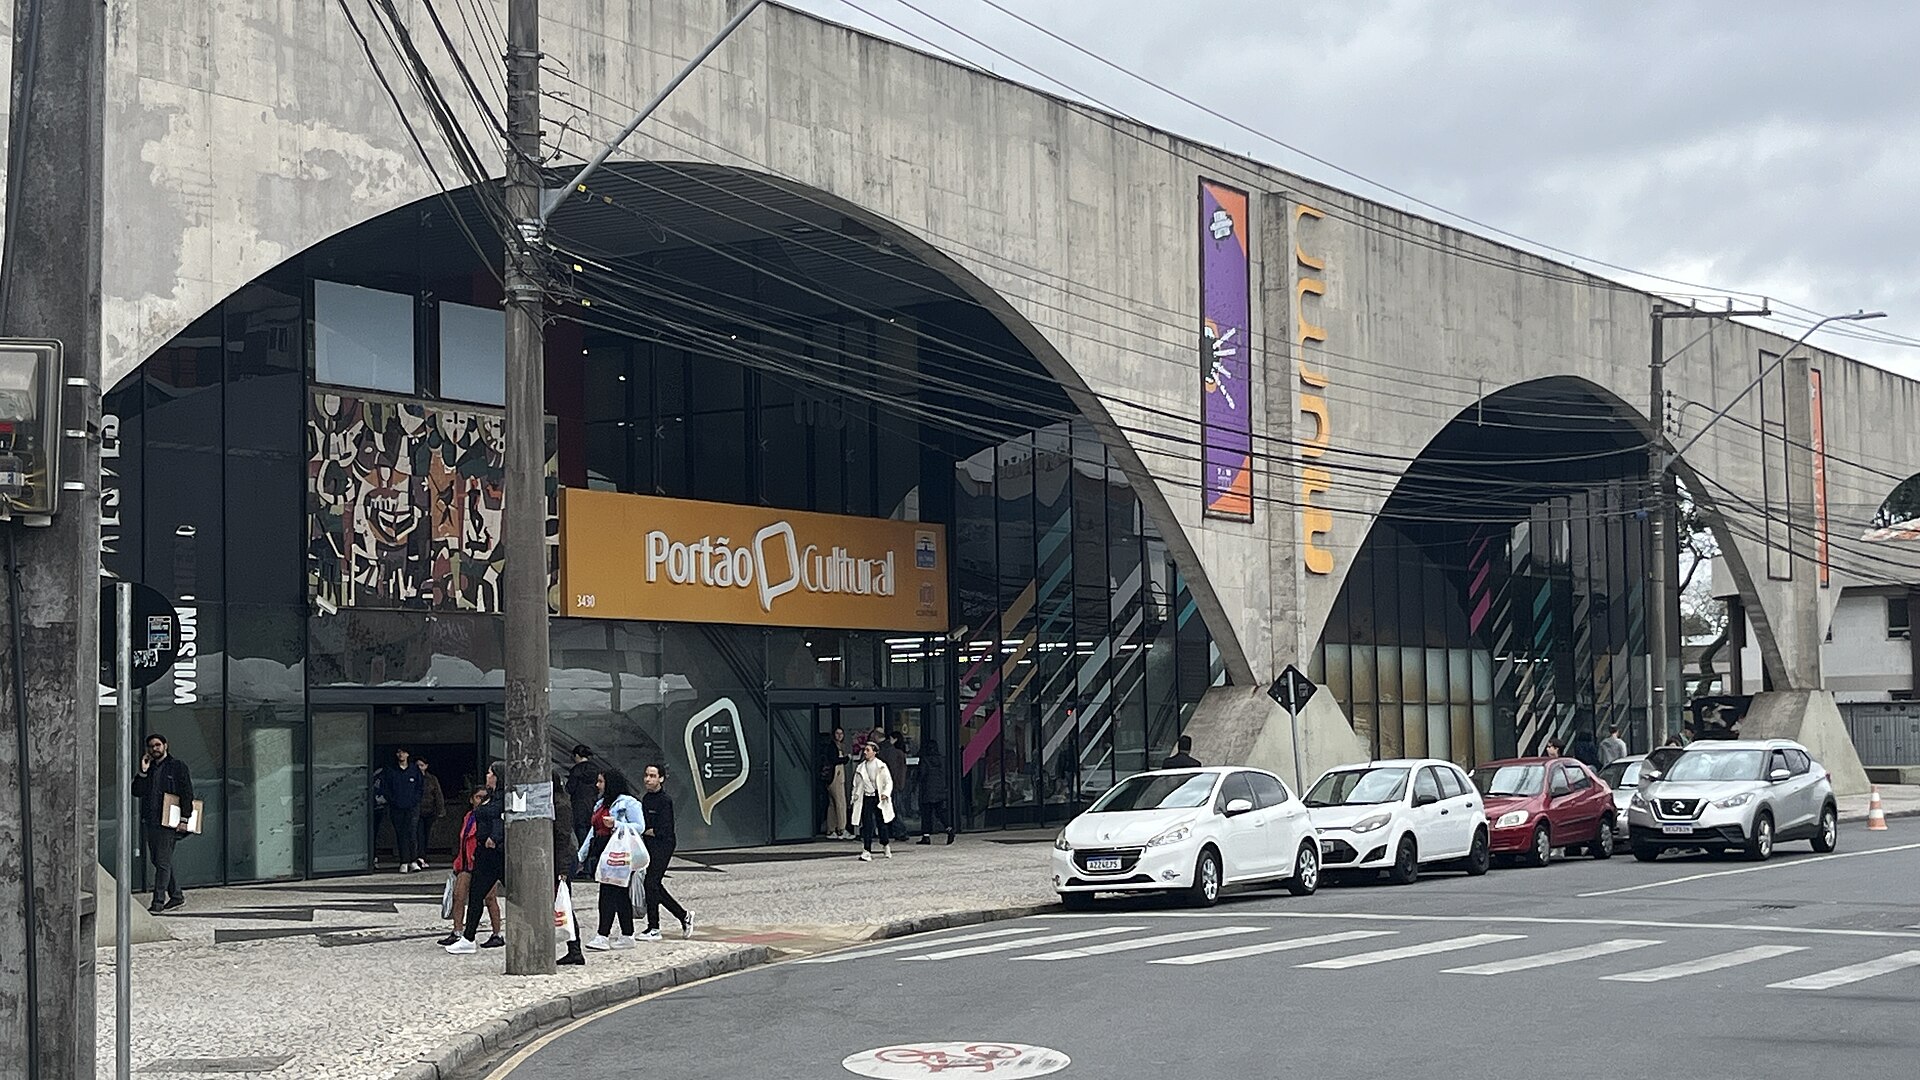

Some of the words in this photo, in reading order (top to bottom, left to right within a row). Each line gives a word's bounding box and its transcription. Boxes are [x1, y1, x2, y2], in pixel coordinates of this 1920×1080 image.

[645, 531, 753, 588] Portão
[801, 545, 895, 596] Cultural
[576, 594, 596, 608] 3430
[174, 607, 197, 704] WILSON
[704, 721, 710, 737] 1
[704, 742, 712, 758] T
[704, 763, 712, 778] S
